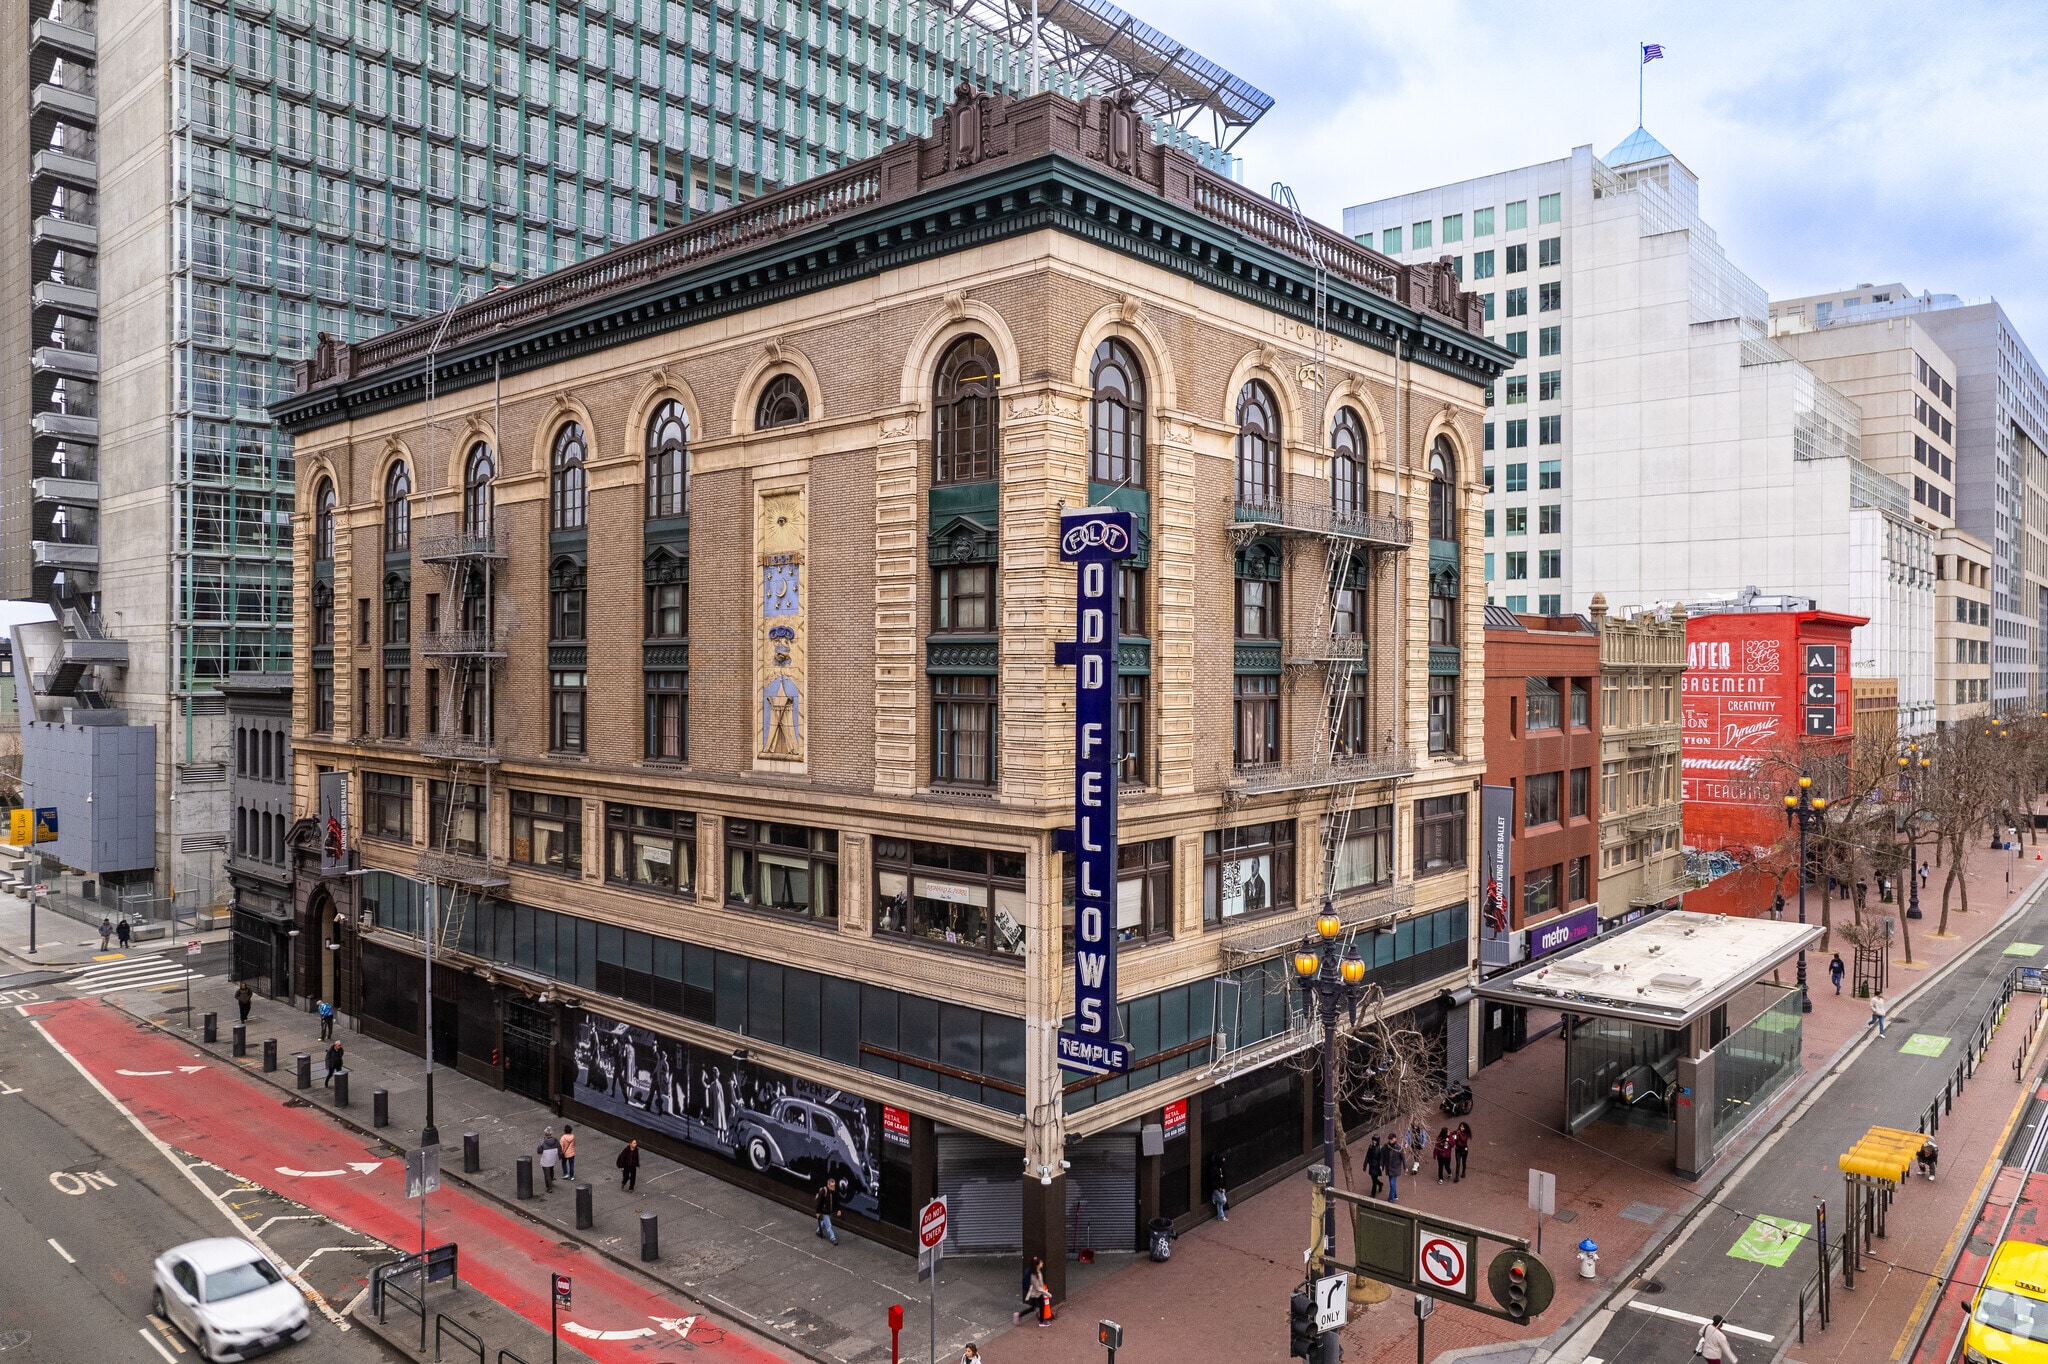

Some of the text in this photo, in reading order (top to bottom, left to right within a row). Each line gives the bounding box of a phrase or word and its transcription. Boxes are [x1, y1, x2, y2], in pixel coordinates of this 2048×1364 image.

[1728, 701, 1776, 712] CREATIVITY
[1722, 716, 1780, 748] Dynamic
[1077, 563, 1106, 1033] ODD FELLOWS
[1705, 783, 1770, 800] TEACHING
[1498, 816, 1506, 842] BALLET
[1496, 864, 1504, 881] KING
[1496, 882, 1504, 910] ALONZO
[1542, 926, 1569, 949] metro
[1060, 1036, 1123, 1068] TEMPLE
[924, 1206, 943, 1224] DO NOT
[925, 1226, 942, 1242] ENTER
[2019, 1281, 2040, 1293] TAXI
[1321, 1310, 1341, 1326] ONLY
